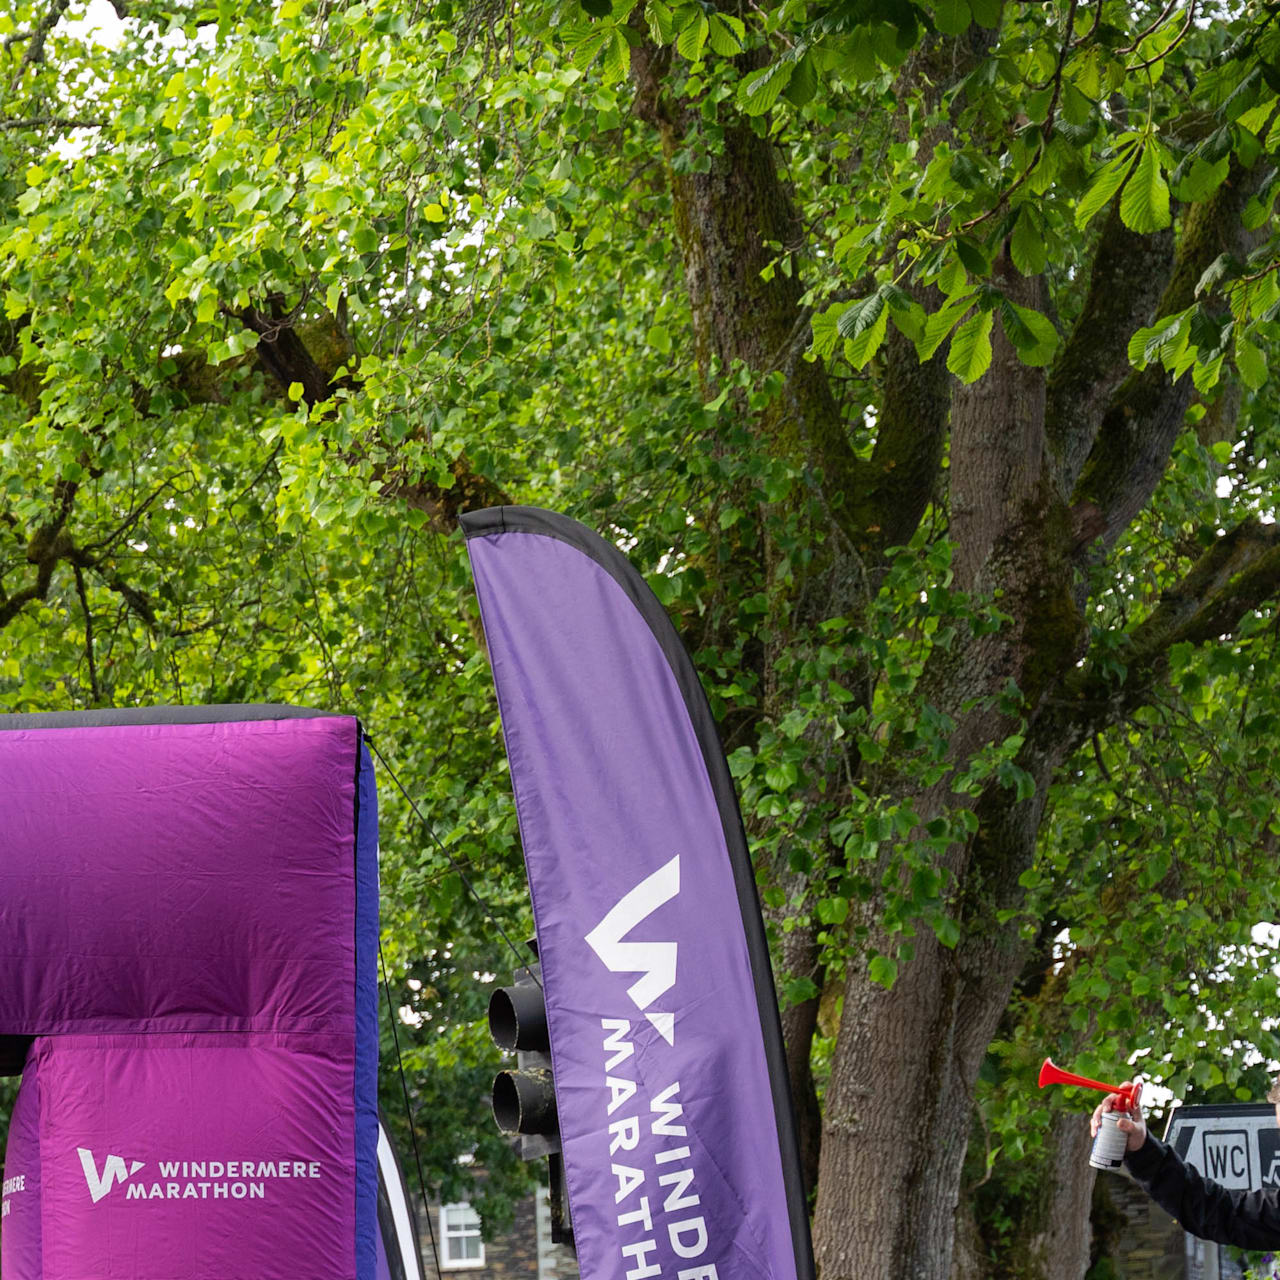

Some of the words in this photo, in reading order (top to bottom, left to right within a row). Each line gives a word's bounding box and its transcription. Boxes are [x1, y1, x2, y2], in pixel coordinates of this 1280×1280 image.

[158, 1160, 321, 1178] WINDERMERE
[1208, 1145, 1246, 1179] WC
[125, 1182, 265, 1200] MARATHON
